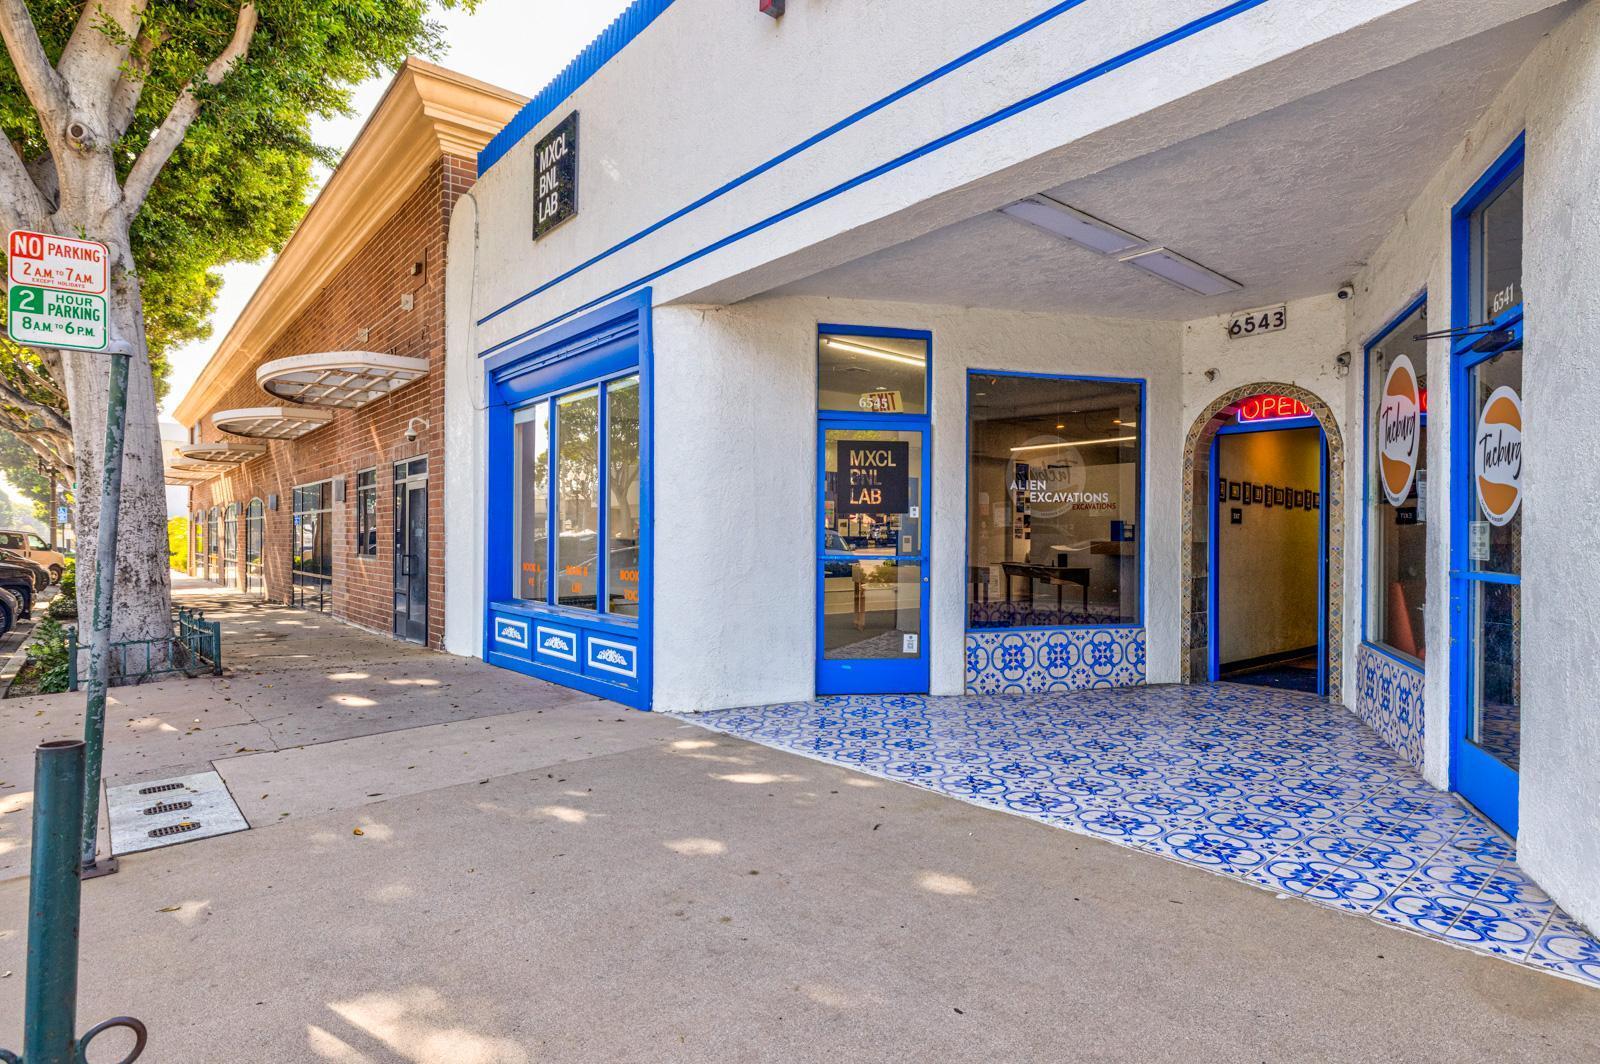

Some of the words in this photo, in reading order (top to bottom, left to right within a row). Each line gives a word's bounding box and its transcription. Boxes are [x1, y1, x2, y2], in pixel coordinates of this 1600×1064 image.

[540, 133, 568, 172] MXCL
[540, 166, 559, 198] BNL
[538, 192, 558, 223] LAB
[15, 235, 41, 257] NO
[48, 243, 100, 262] PARKING
[23, 262, 32, 275] 2
[65, 267, 74, 281] 7
[57, 280, 86, 289] HOLIDAYS
[19, 289, 35, 311] 2
[55, 294, 93, 307] HOUR
[1493, 282, 1514, 313] 6541
[47, 303, 101, 322] PARKING
[22, 316, 32, 330] 8
[65, 321, 75, 335] 6
[1230, 311, 1284, 335] 6543
[859, 397, 889, 409] 6545
[869, 391, 897, 412] EXIT
[1242, 396, 1311, 419] OPEN
[849, 449, 897, 467] MXCL
[849, 469, 882, 486] BNL
[1010, 480, 1047, 490] ALIEN
[849, 488, 882, 505] LAB
[1029, 492, 1109, 503] EXCAVATIONS
[1072, 503, 1117, 511] EXCAVATIONS
